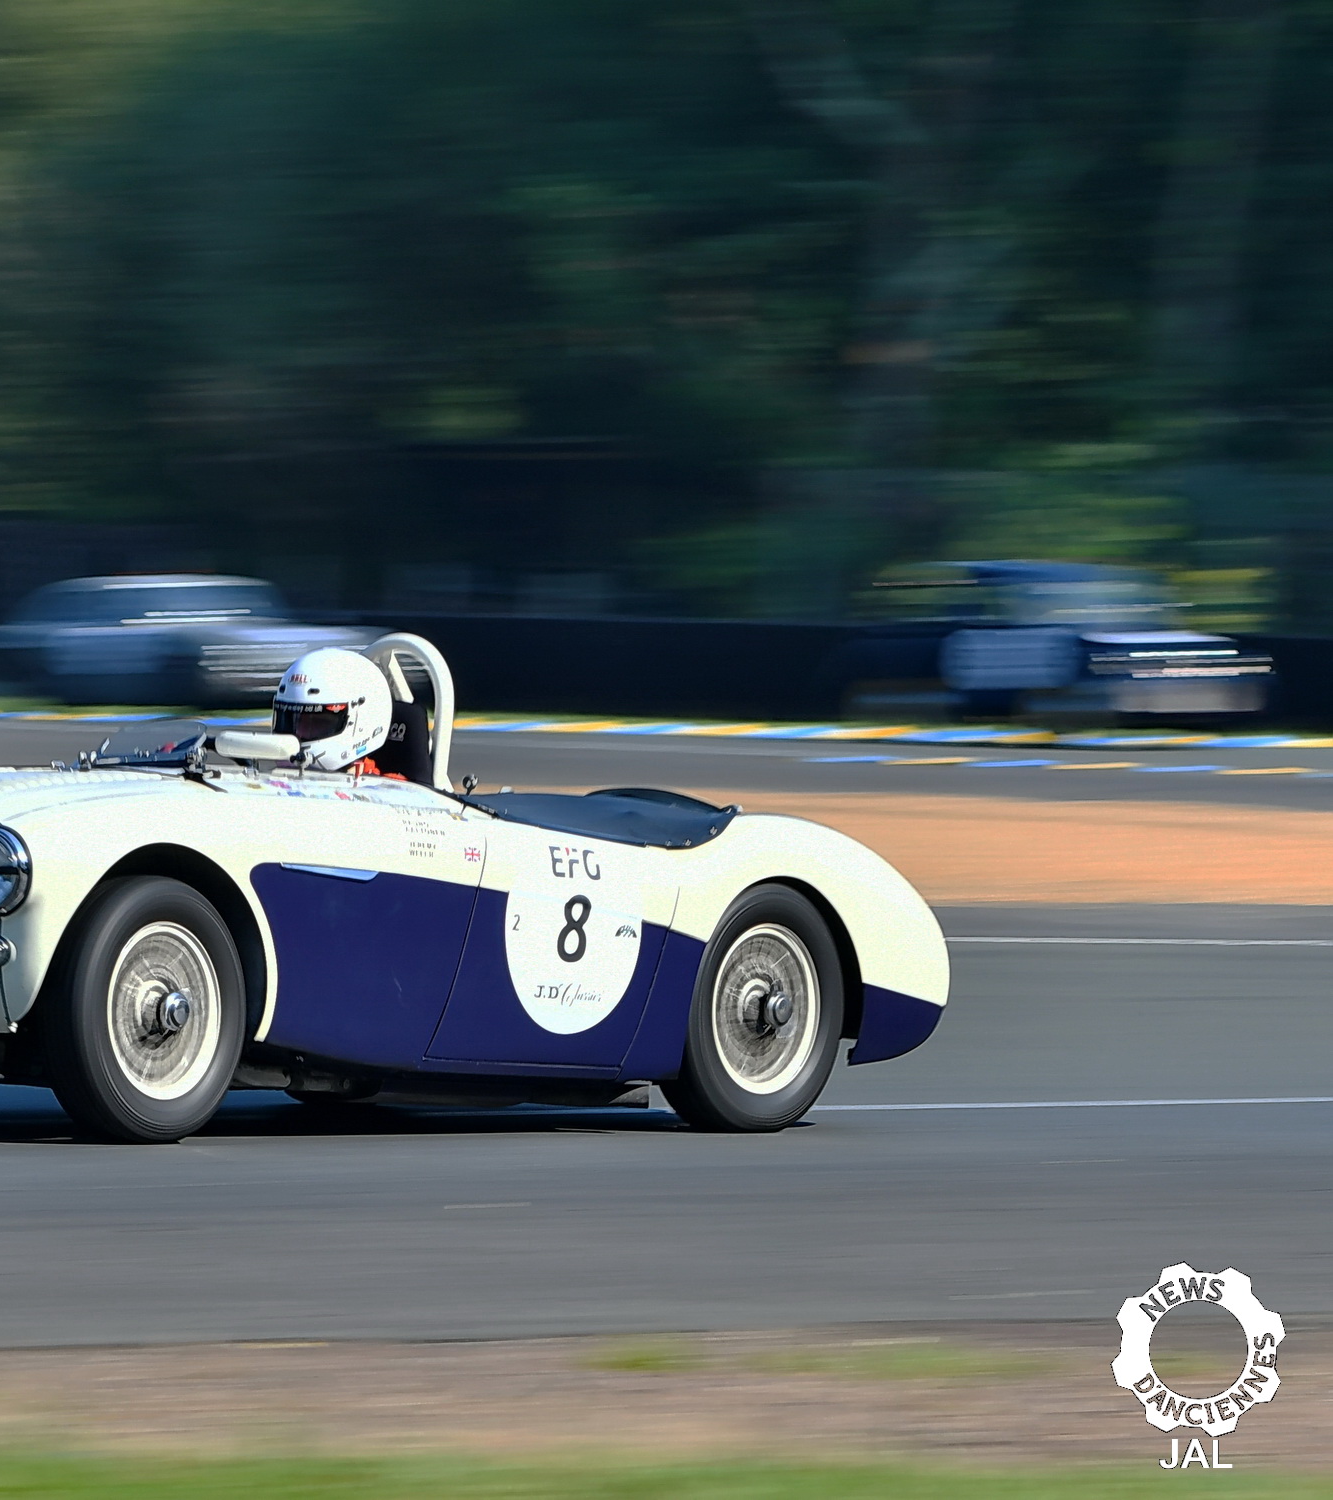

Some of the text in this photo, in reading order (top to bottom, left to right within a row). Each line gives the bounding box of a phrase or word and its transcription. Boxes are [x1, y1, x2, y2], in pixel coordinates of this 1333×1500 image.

[549, 845, 601, 881] EFG
[512, 914, 521, 931] 2
[556, 894, 592, 963] 8
